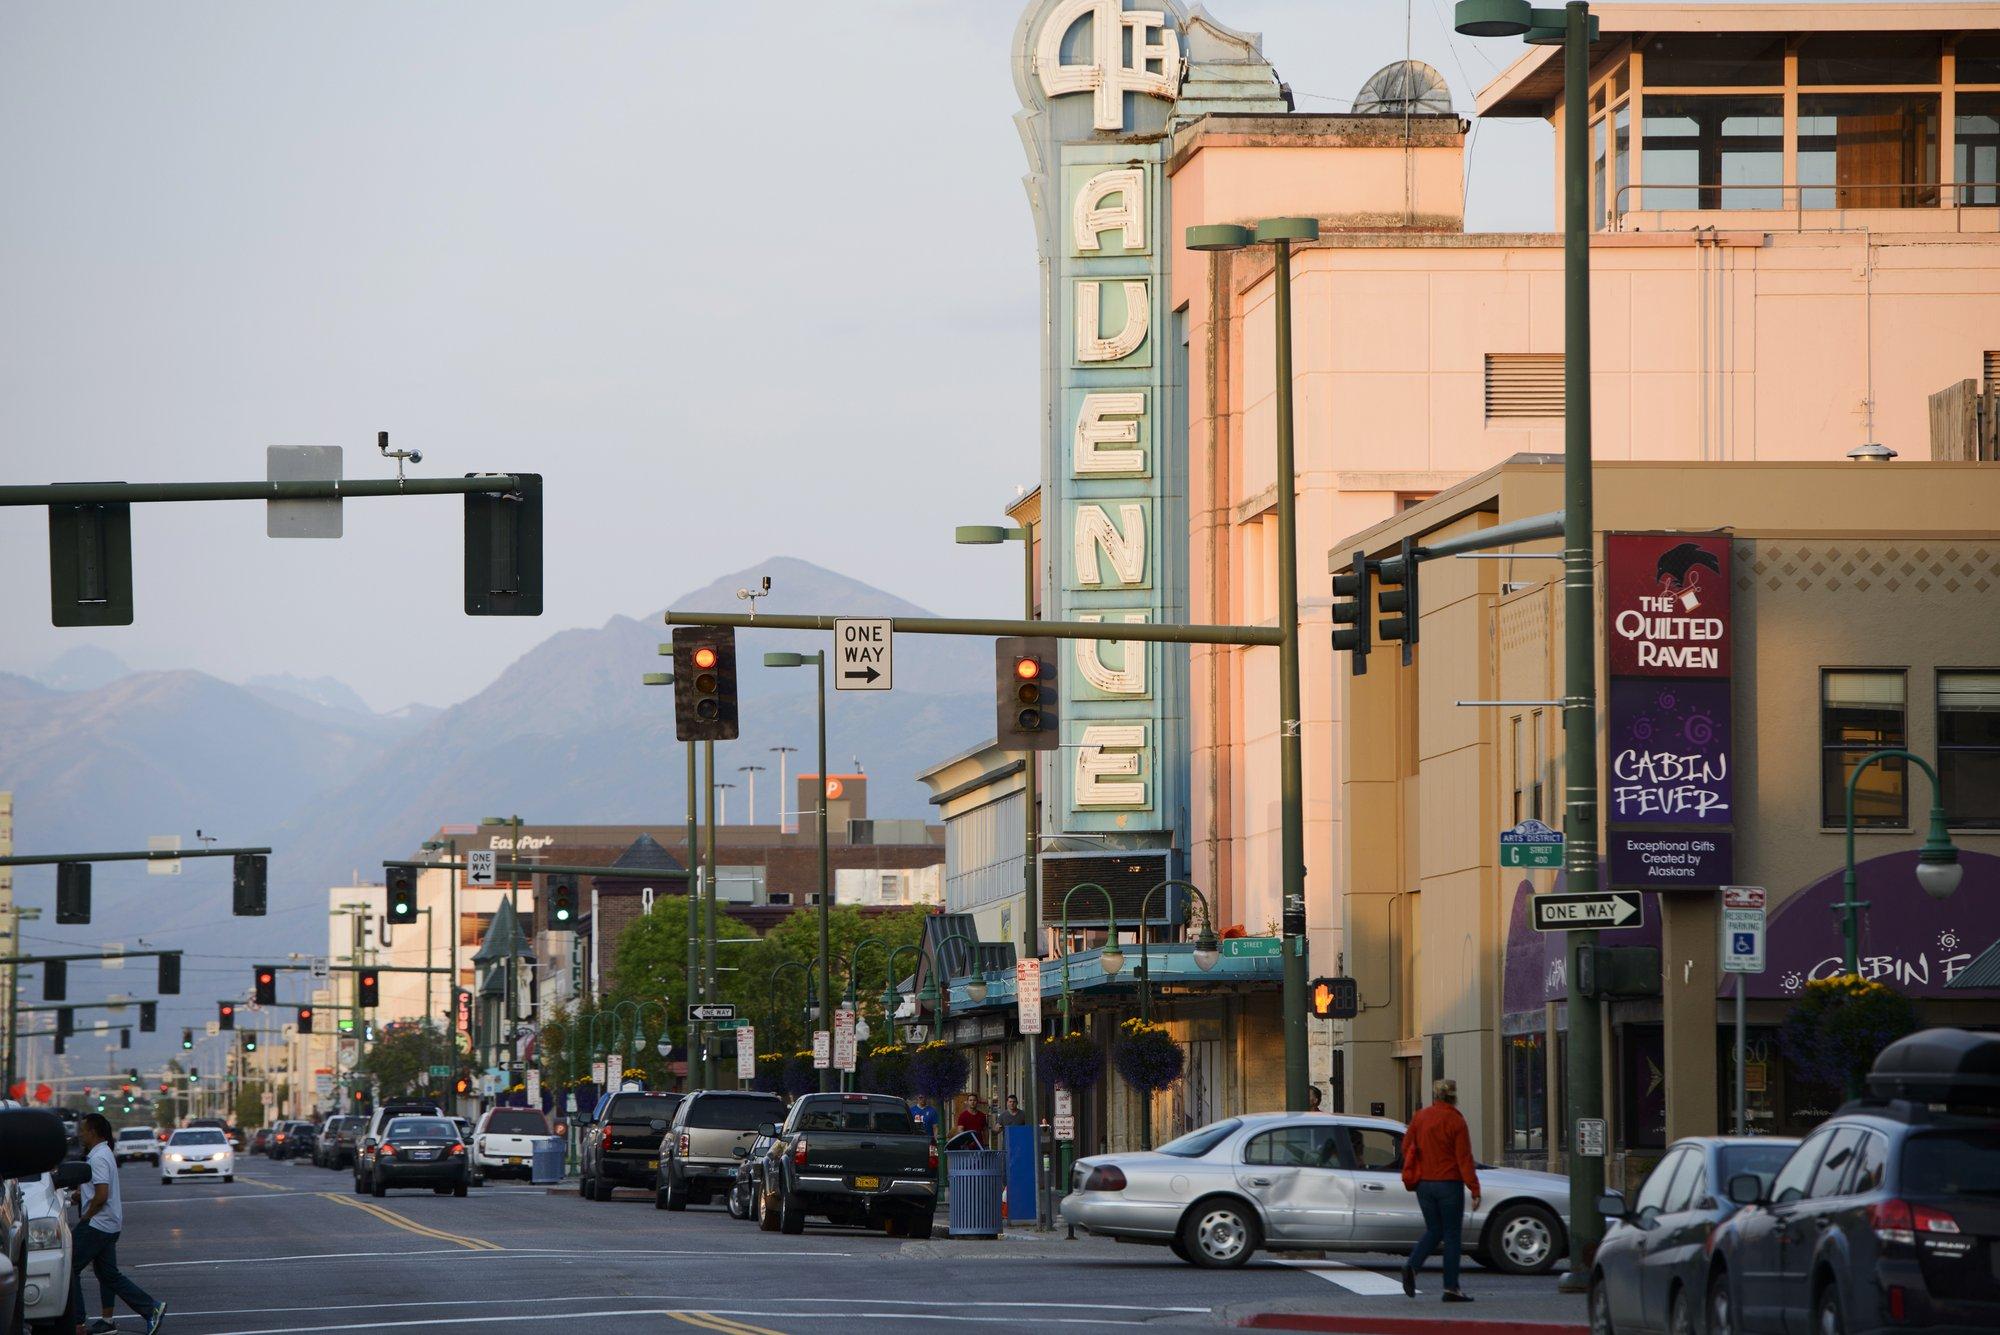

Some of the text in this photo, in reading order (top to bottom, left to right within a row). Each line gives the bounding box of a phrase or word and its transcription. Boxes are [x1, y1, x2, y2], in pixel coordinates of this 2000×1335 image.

[1639, 596, 1674, 613] THE
[1615, 609, 1724, 640] QUILTED
[845, 626, 883, 642] ONE
[845, 647, 884, 663] WAY
[1638, 640, 1719, 669] RAVEN
[1614, 749, 1727, 783] CABIN
[1614, 785, 1729, 818] FEVER
[1503, 834, 1561, 842] ARTS DISTRICT
[1627, 840, 1716, 853] Exceptional Gifts
[472, 853, 491, 861] ONE
[1511, 846, 1520, 864] G
[1534, 856, 1549, 864] 400
[1642, 853, 1701, 866] Created by
[1648, 865, 1696, 877] Alaskans
[1545, 903, 1617, 919] ONE WAY
[1726, 912, 1763, 921] RESERVED
[1728, 922, 1761, 931] PARKING
[1231, 941, 1263, 955] G STREET
